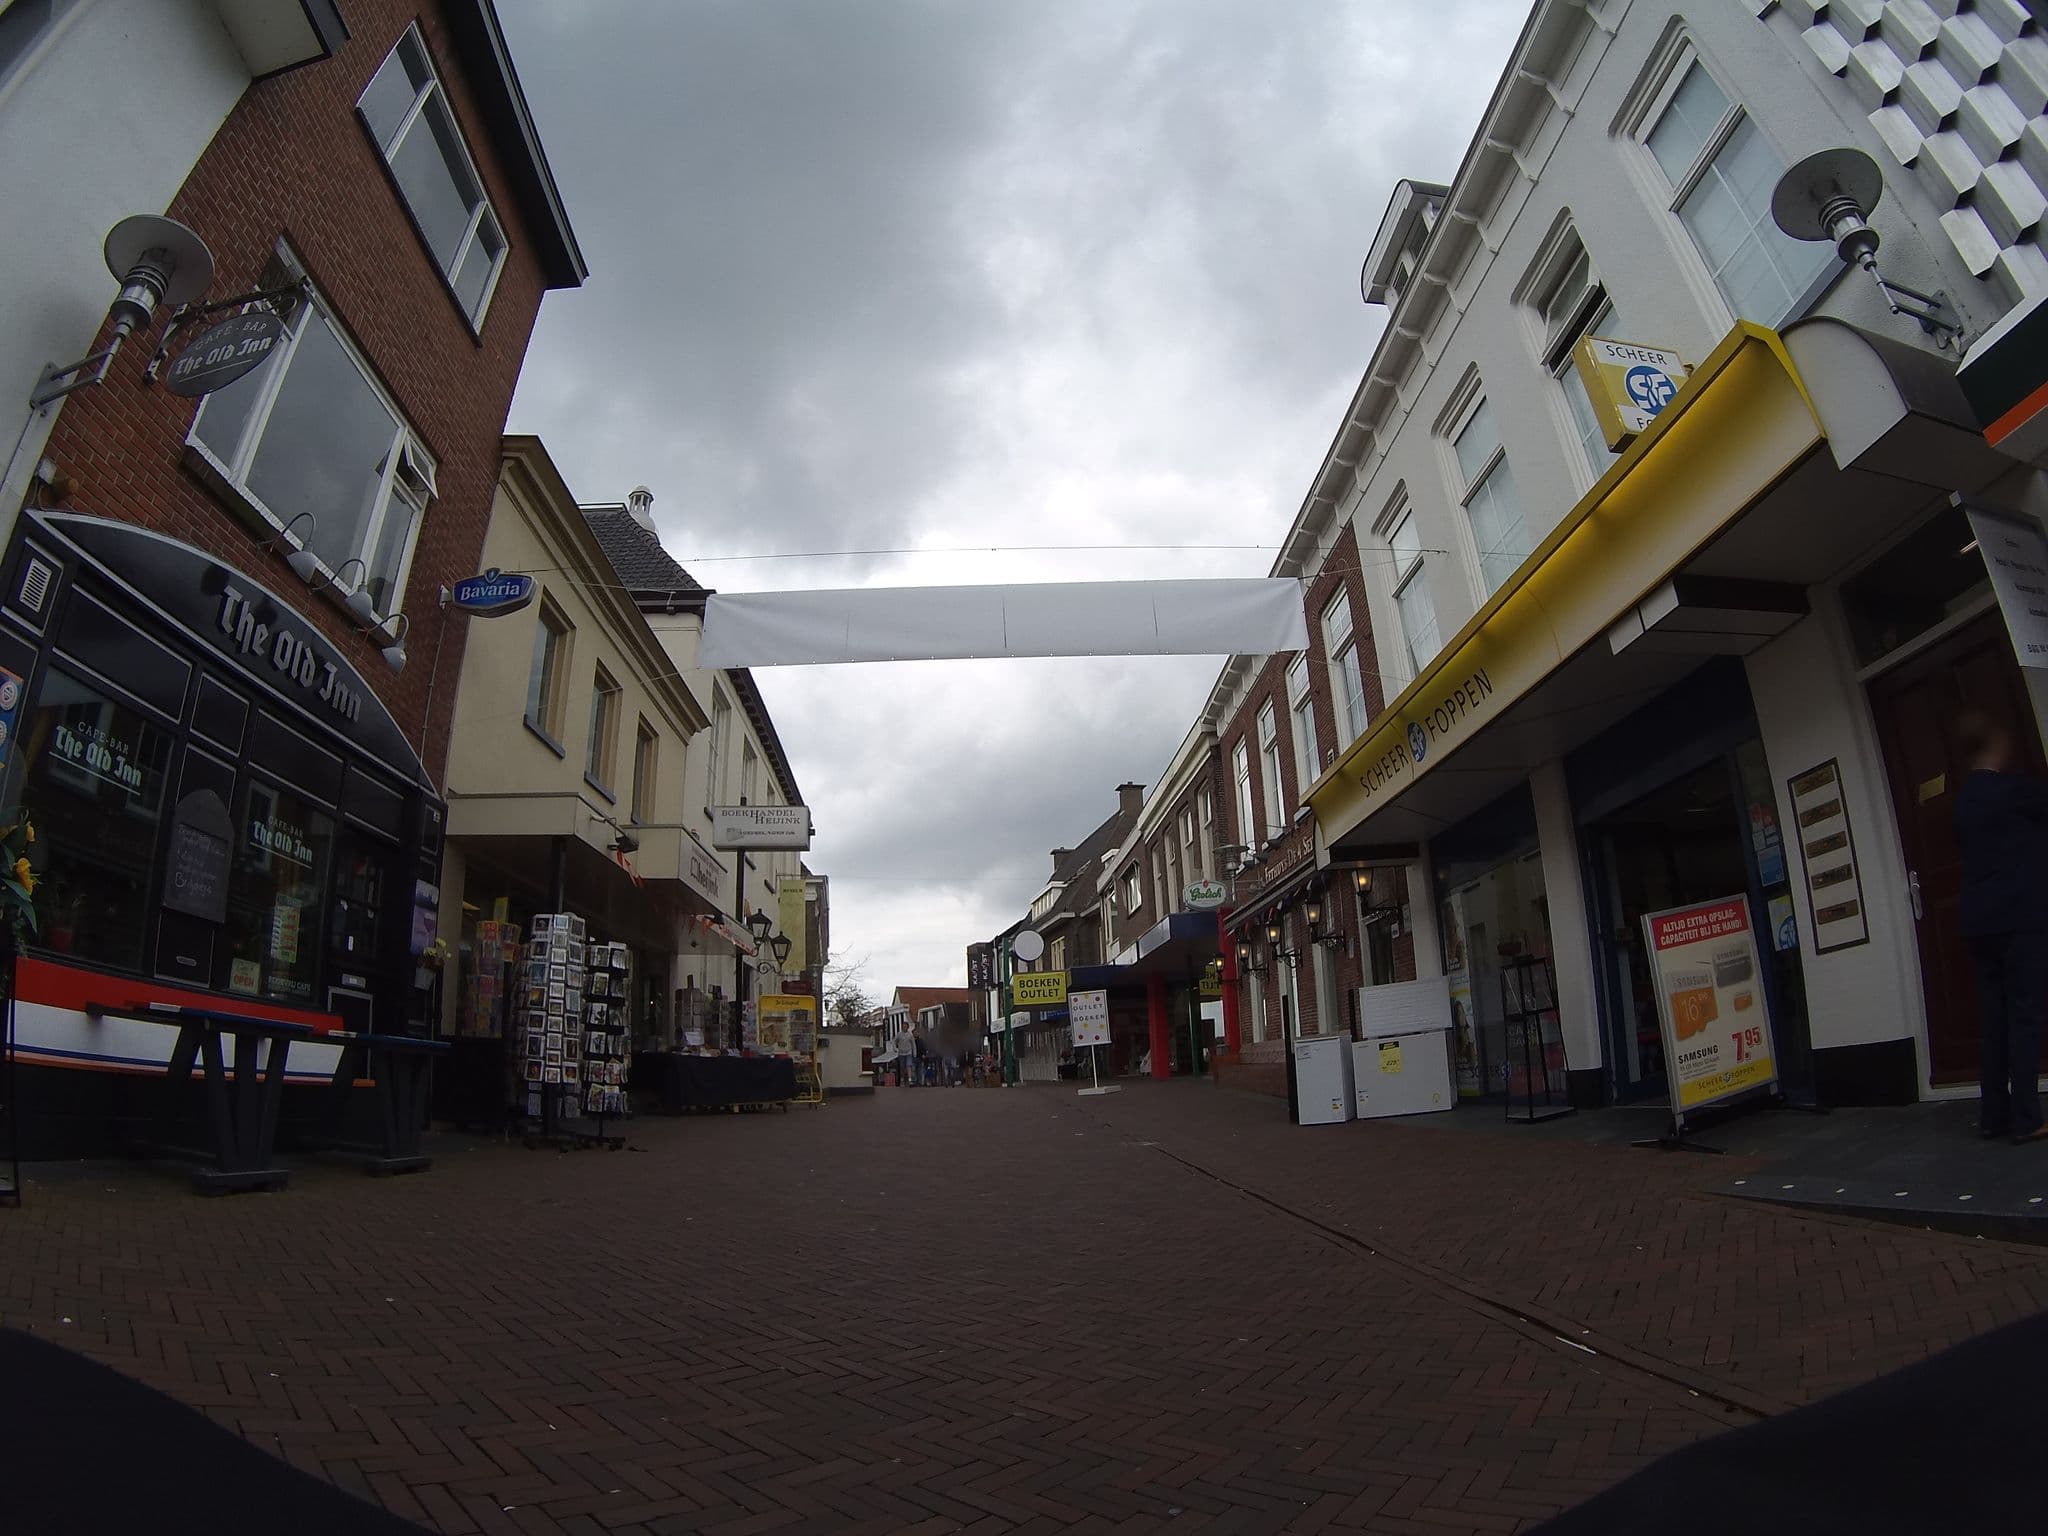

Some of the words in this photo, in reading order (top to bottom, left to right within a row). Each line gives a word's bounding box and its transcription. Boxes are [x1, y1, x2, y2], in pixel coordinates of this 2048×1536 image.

[175, 356, 203, 375] The
[205, 344, 235, 365] Old
[236, 336, 272, 356] Inn
[1606, 344, 1667, 365] SCHEER
[461, 581, 520, 600] Bavaria
[221, 585, 269, 656] The
[273, 630, 316, 688] Old
[319, 661, 361, 722] Inn
[1360, 744, 1409, 798] SCHEER
[1424, 668, 1493, 742] FOPPEN
[55, 725, 84, 760] The
[85, 742, 112, 772] Old
[114, 755, 142, 787] Inn
[721, 809, 796, 818] BOEKHANDEL
[755, 816, 801, 825] HEIJINK
[253, 820, 272, 846] The
[274, 831, 292, 853] Old
[294, 839, 312, 863] Inn
[1189, 886, 1222, 901] Grolsch
[1663, 920, 1686, 933] ALTIJD
[1687, 916, 1708, 929] EXTRA
[1709, 909, 1737, 923] OPSLAG-
[1660, 929, 1699, 945] CAPACITEIT
[1700, 926, 1712, 937] BIJ
[1712, 923, 1722, 933] DE
[234, 974, 255, 988] OPEN
[1019, 977, 1061, 988] BOEKEN
[1020, 988, 1060, 999] OUTLET
[1072, 1003, 1104, 1012] OUTLET
[1073, 1014, 1106, 1022] BOEKEN
[1678, 1045, 1719, 1064] SAMSUNG
[1698, 1076, 1723, 1089] SCHEER
[1731, 1066, 1755, 1079] FOPPEN
